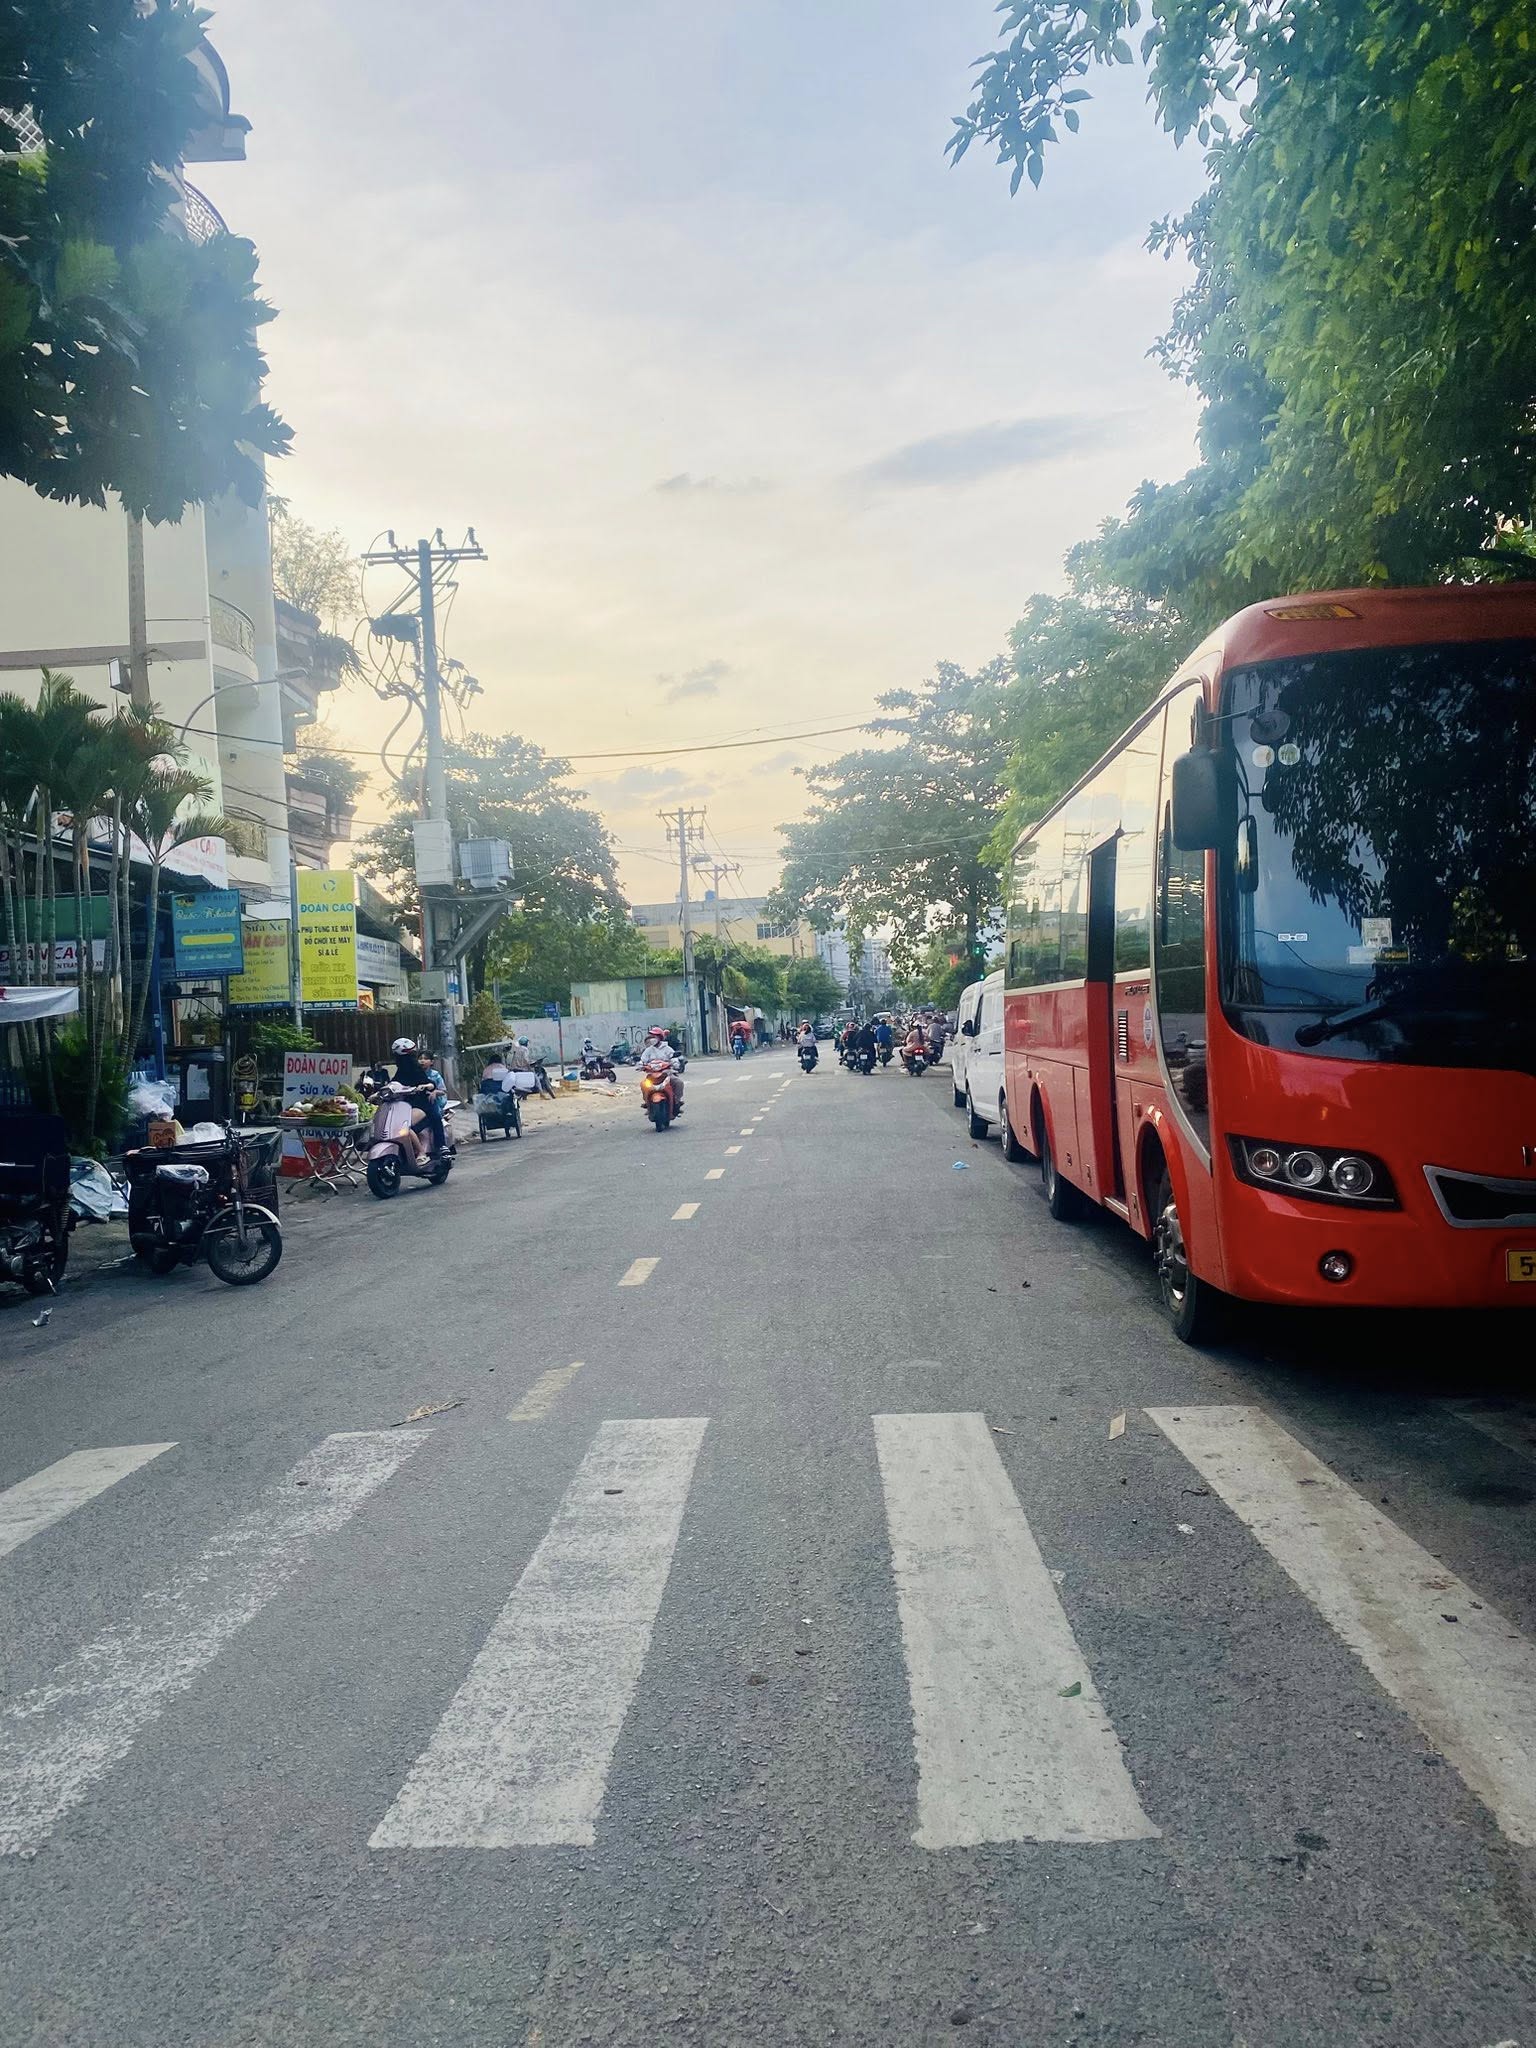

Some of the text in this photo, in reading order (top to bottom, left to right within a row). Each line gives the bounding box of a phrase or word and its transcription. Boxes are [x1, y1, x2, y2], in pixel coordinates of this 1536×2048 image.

[332, 902, 354, 912] CAO
[269, 922, 284, 931] Xe
[319, 1058, 340, 1075] CAO
[321, 1085, 335, 1096] Xe
[1520, 1256, 1536, 1277] 5
